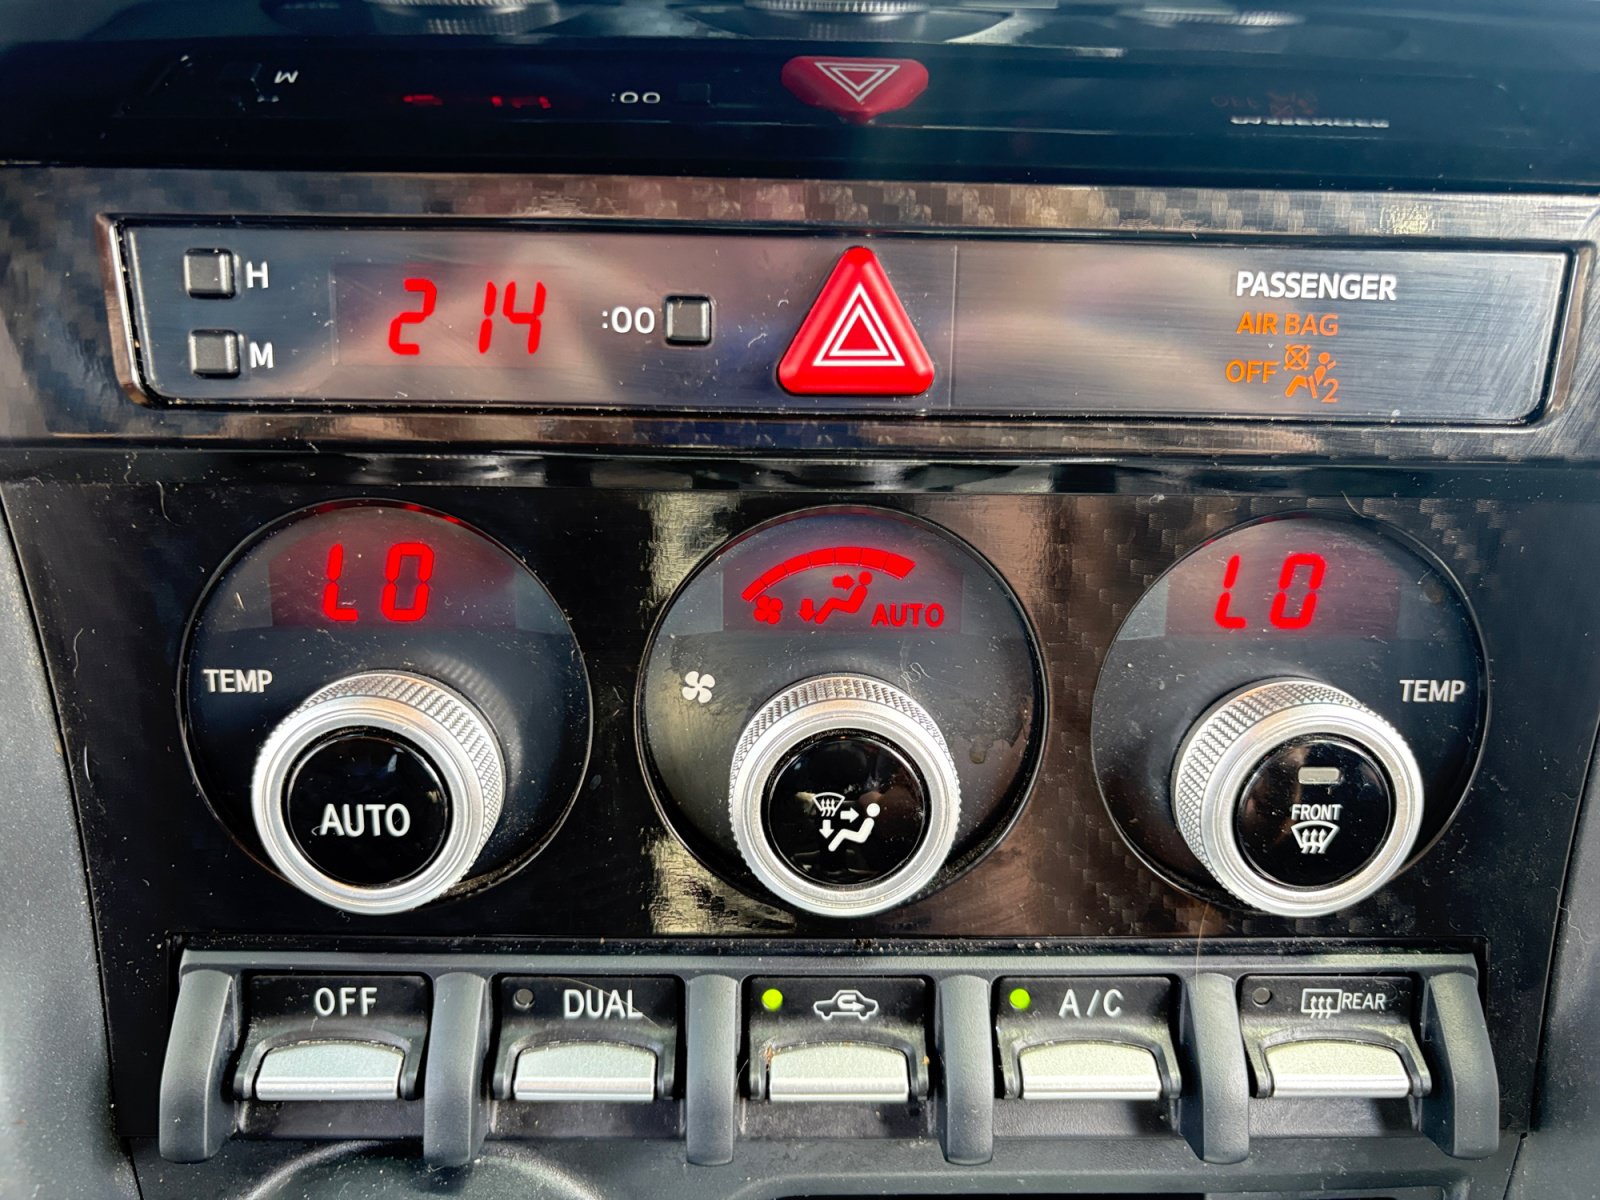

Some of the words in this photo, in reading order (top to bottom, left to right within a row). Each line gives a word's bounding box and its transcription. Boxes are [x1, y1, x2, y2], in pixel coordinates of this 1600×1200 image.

[246, 262, 269, 289] H
[1236, 271, 1397, 301] PASSENGER
[601, 305, 656, 334] :00
[1236, 311, 1279, 335] AIR
[1284, 313, 1339, 336] BAG
[249, 341, 274, 369] M
[1225, 359, 1279, 384] OFF
[871, 602, 945, 628] AUTO
[204, 668, 273, 693] TEMP
[1400, 679, 1466, 703] TEMP
[319, 803, 411, 838] AUTO
[1290, 803, 1342, 821] FRONT
[314, 986, 378, 1018] OFF
[563, 988, 643, 1020] DUAL
[1058, 988, 1124, 1018] A/C
[1341, 993, 1387, 1011] REAR
